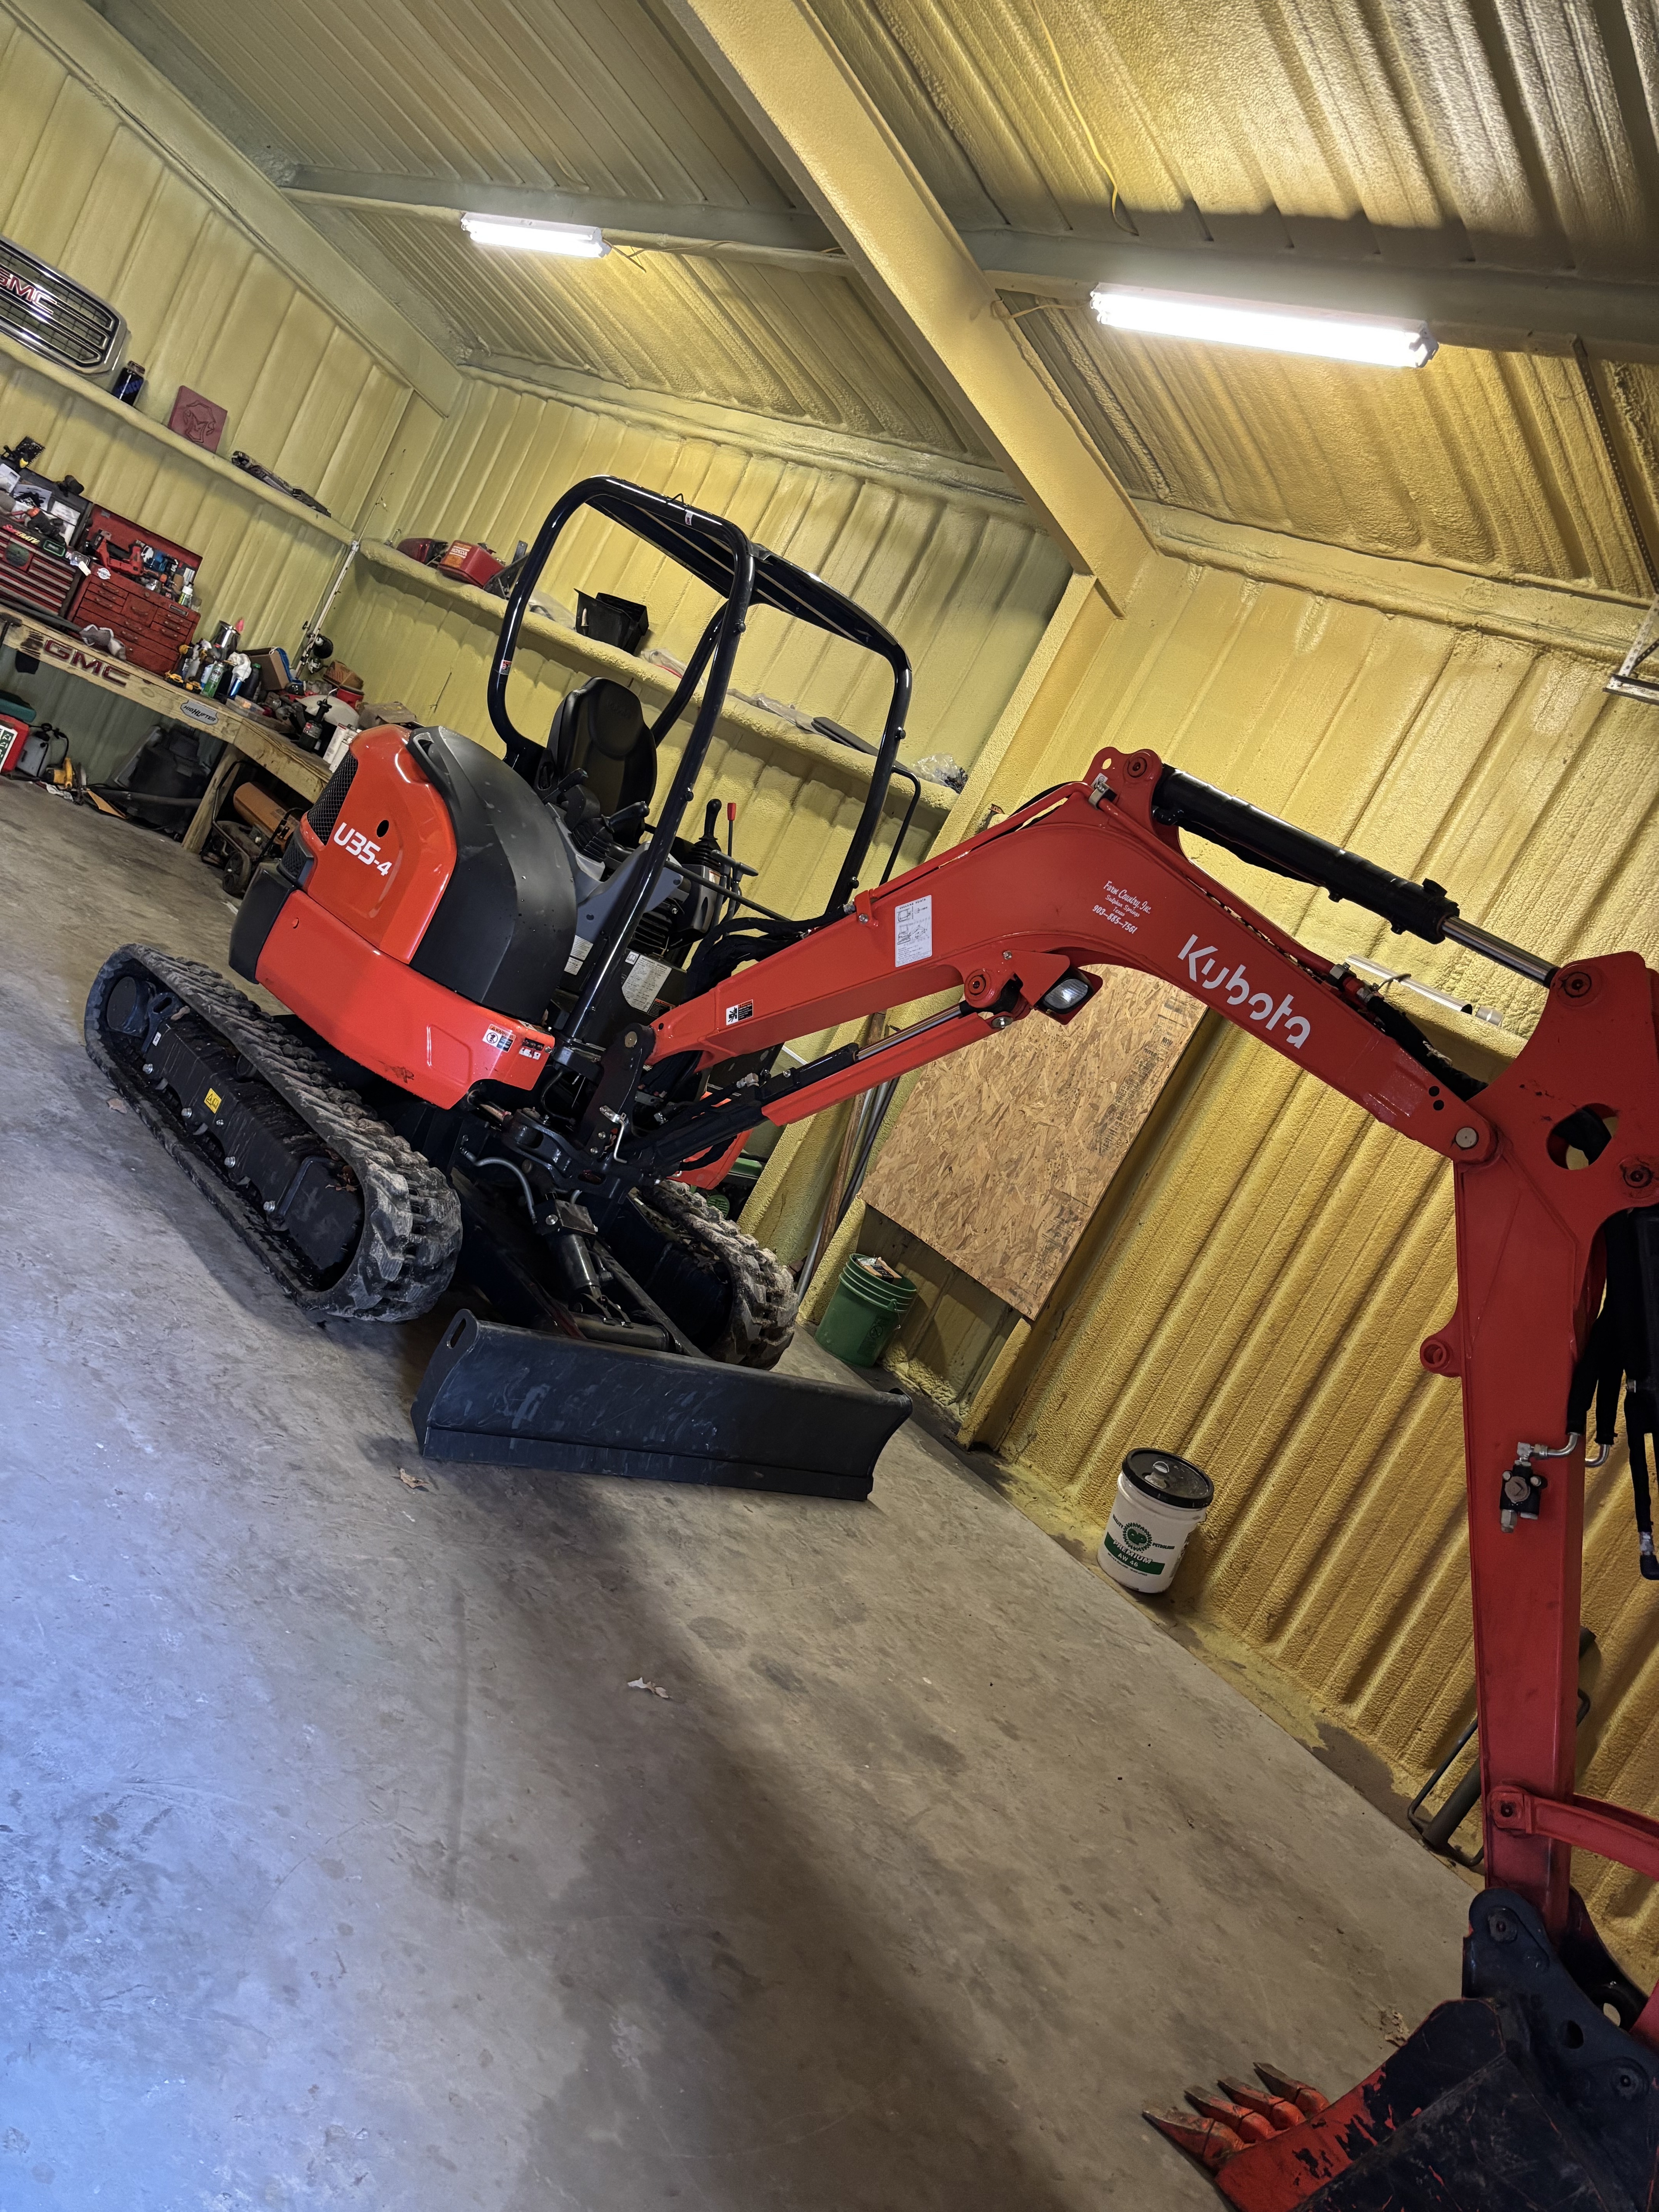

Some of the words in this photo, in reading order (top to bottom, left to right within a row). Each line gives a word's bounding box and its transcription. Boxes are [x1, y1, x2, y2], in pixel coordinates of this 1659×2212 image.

[44, 639, 131, 688] GMC
[333, 822, 392, 876] U35-4
[1103, 880, 1119, 895] Farm
[1139, 901, 1152, 914] Inc.
[1105, 895, 1123, 908] Sulphur
[1123, 905, 1140, 917] Springs
[1092, 905, 1138, 934] 903-885-7561
[1113, 907, 1125, 917] Texas
[1177, 934, 1311, 1049] Kubota
[1161, 1036, 1173, 1046] NOV
[1113, 1539, 1153, 1565] PREMIUM
[1118, 1553, 1128, 1562] AW
